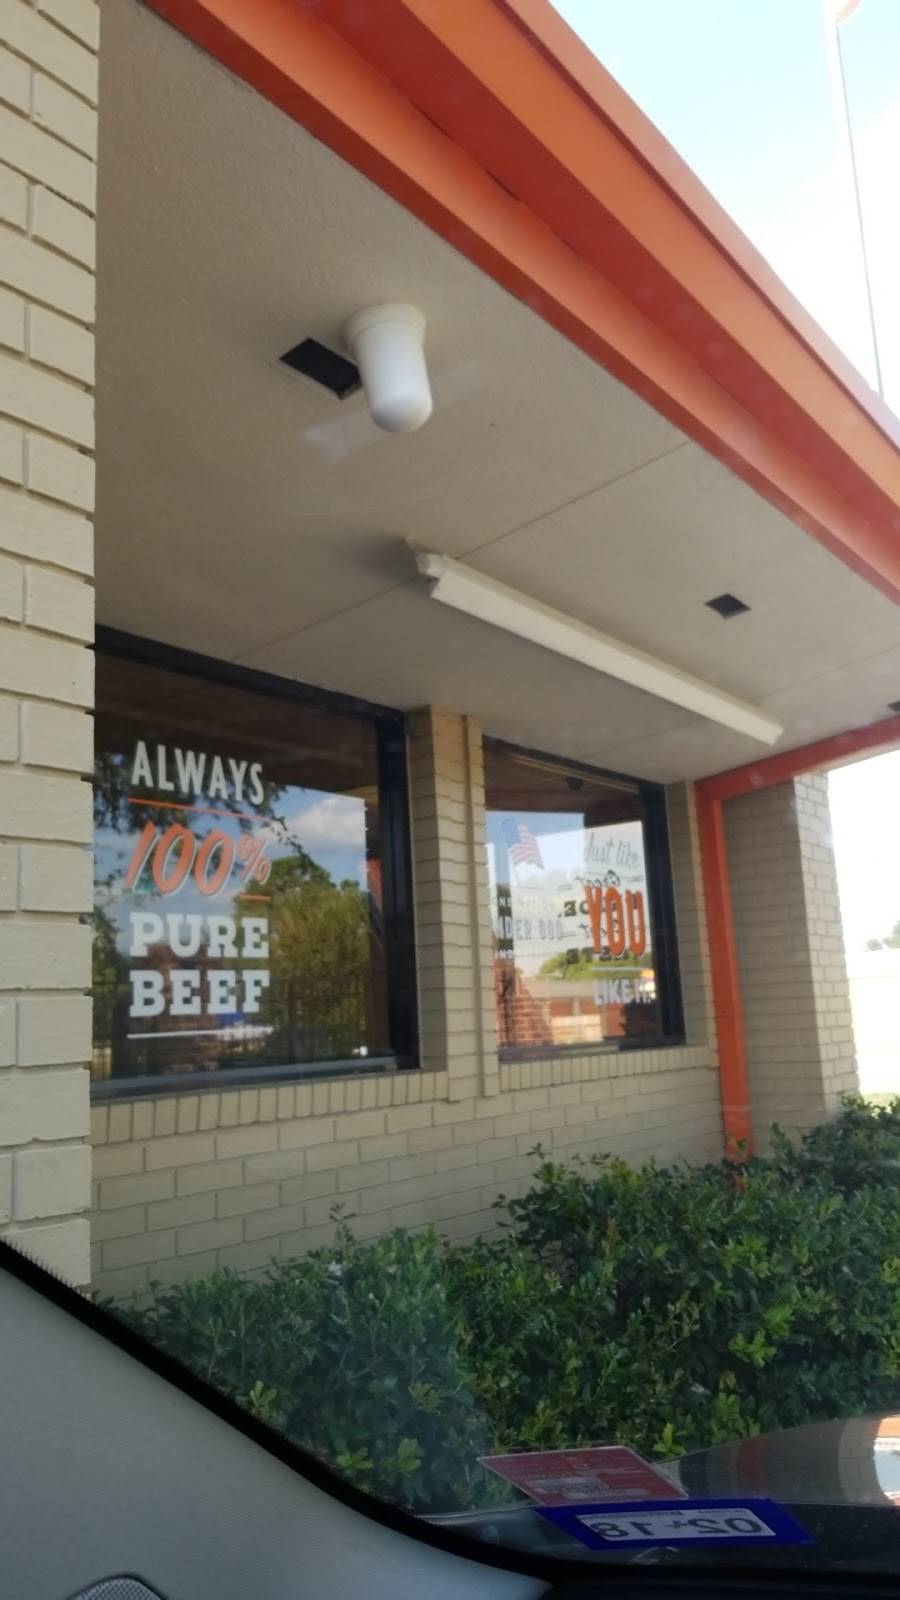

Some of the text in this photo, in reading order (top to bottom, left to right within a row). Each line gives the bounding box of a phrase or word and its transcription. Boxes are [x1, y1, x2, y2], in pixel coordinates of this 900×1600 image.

[131, 740, 265, 805] ALWAYS
[126, 821, 272, 896] 100%
[129, 912, 270, 959] PURE
[585, 883, 647, 957] YOU
[129, 969, 271, 1018] BEEF
[592, 978, 634, 1004] LIKE
